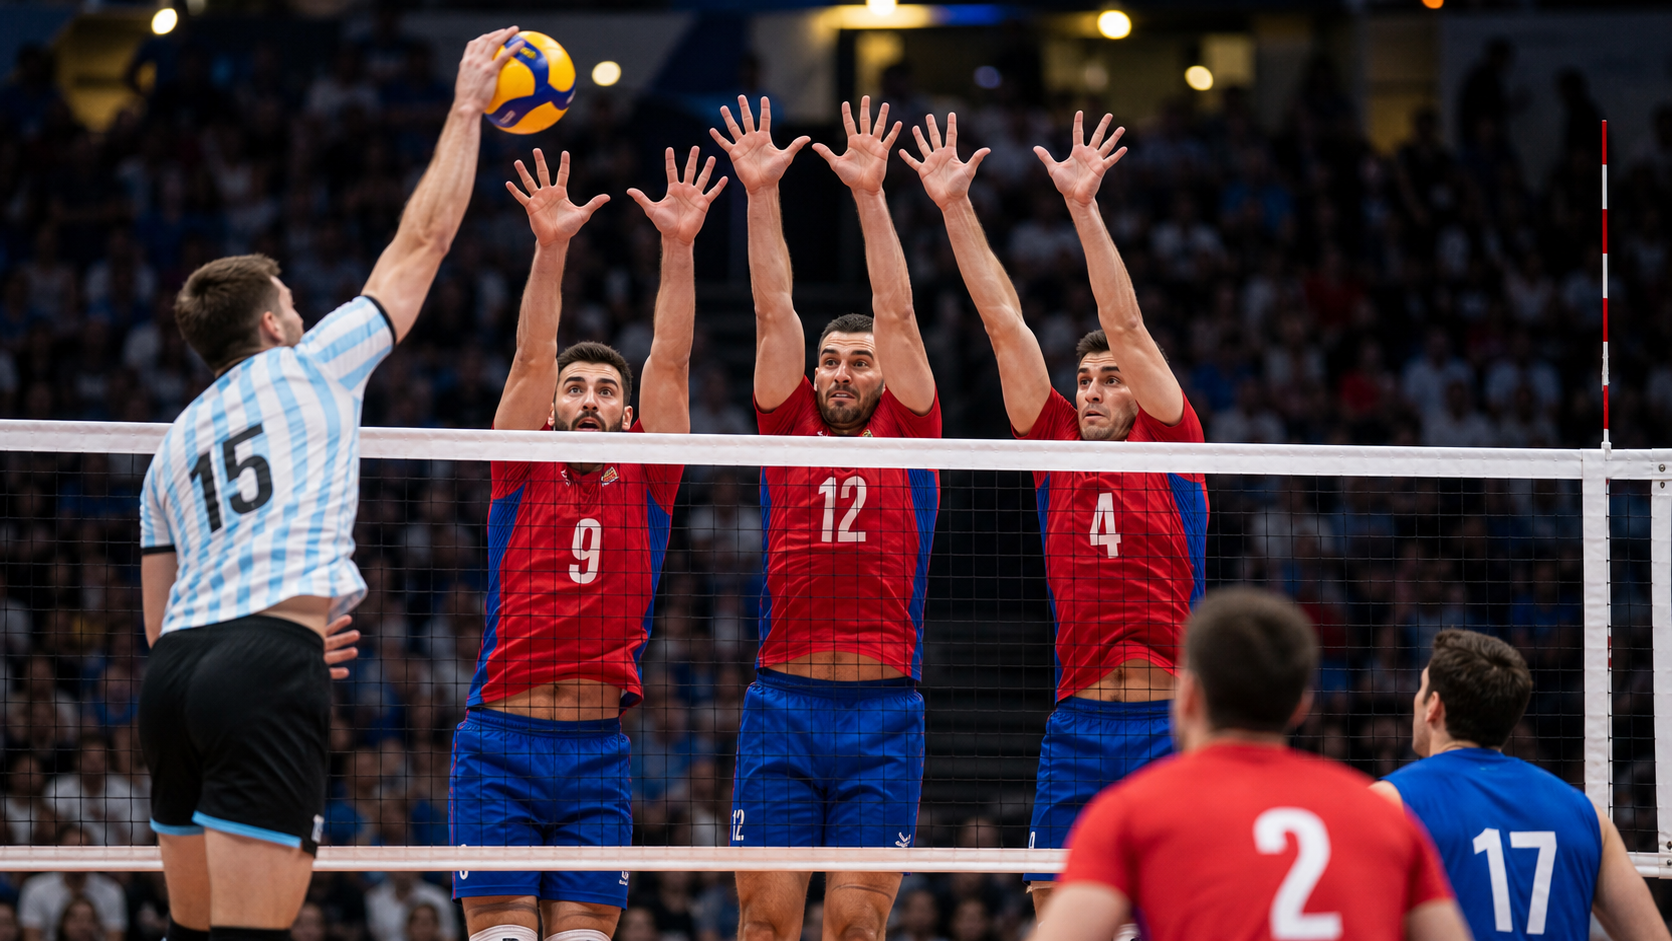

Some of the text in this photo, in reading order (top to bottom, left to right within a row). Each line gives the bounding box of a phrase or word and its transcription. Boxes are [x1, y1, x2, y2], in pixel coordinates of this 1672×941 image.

[189, 424, 273, 532] 15
[818, 475, 867, 543] 12
[568, 517, 602, 585] 9
[1089, 492, 1122, 559] 4
[732, 808, 745, 842] 12
[1253, 807, 1342, 940] 2
[1473, 828, 1558, 935] 17
